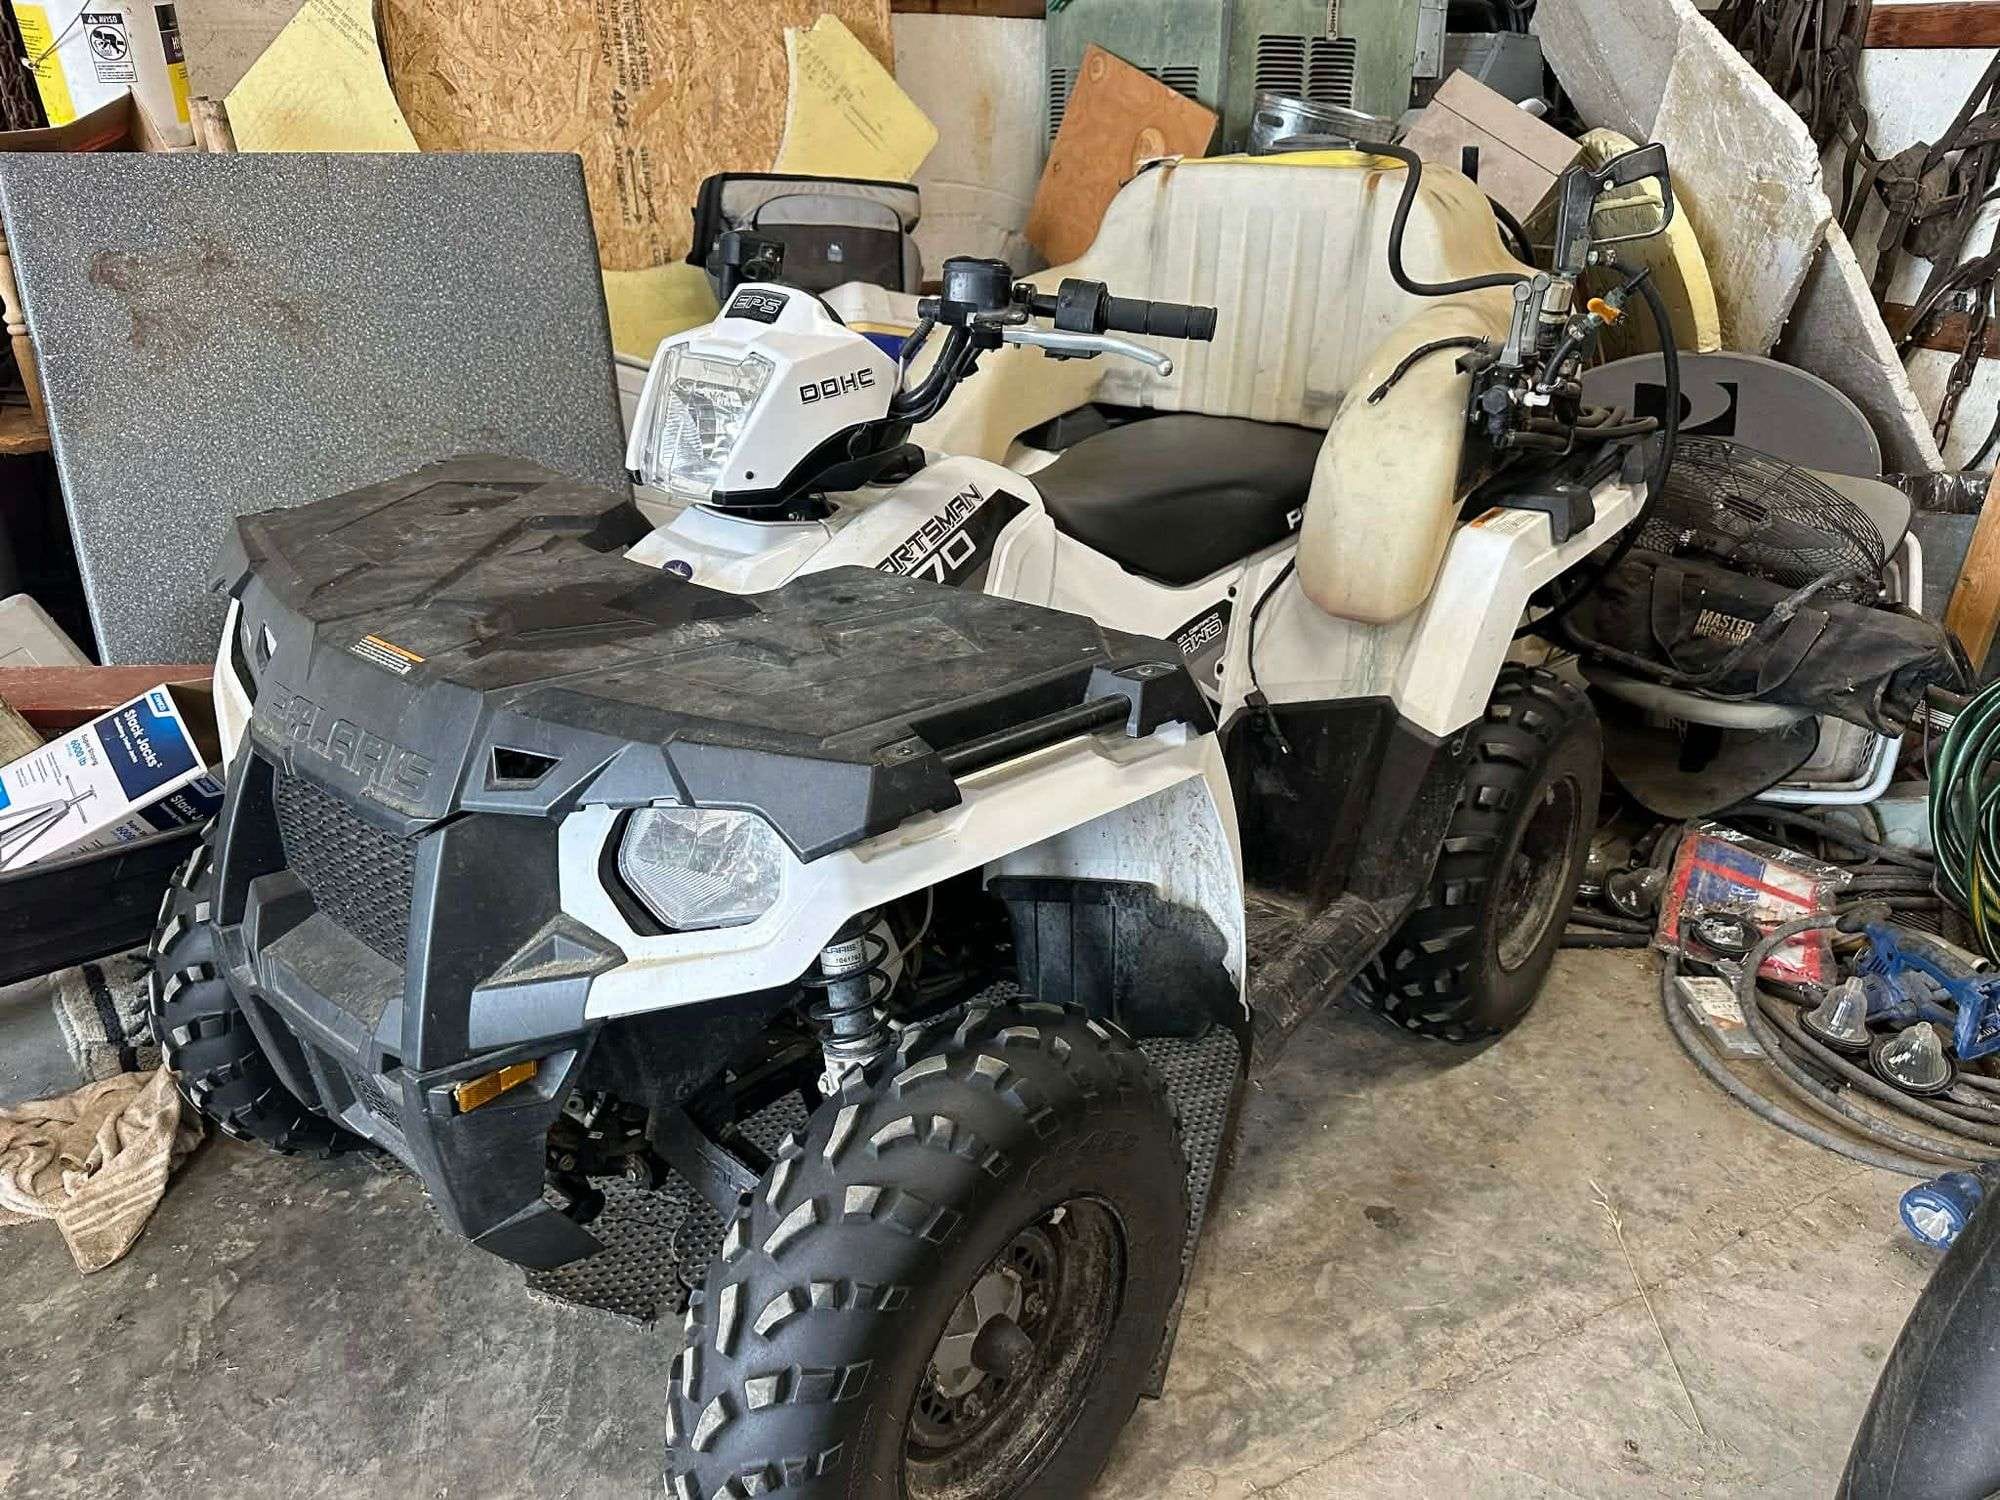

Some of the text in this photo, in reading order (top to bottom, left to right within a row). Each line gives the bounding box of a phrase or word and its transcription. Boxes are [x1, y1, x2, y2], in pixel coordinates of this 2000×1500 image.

[732, 294, 782, 314] EPS
[799, 367, 876, 404] DOHC
[1286, 503, 1306, 530] P
[1179, 618, 1223, 656] AWD
[1693, 623, 1747, 647] MECHANI
[1697, 608, 1755, 638] MASTER
[70, 739, 85, 758] 6000
[263, 679, 437, 803] POLARIS
